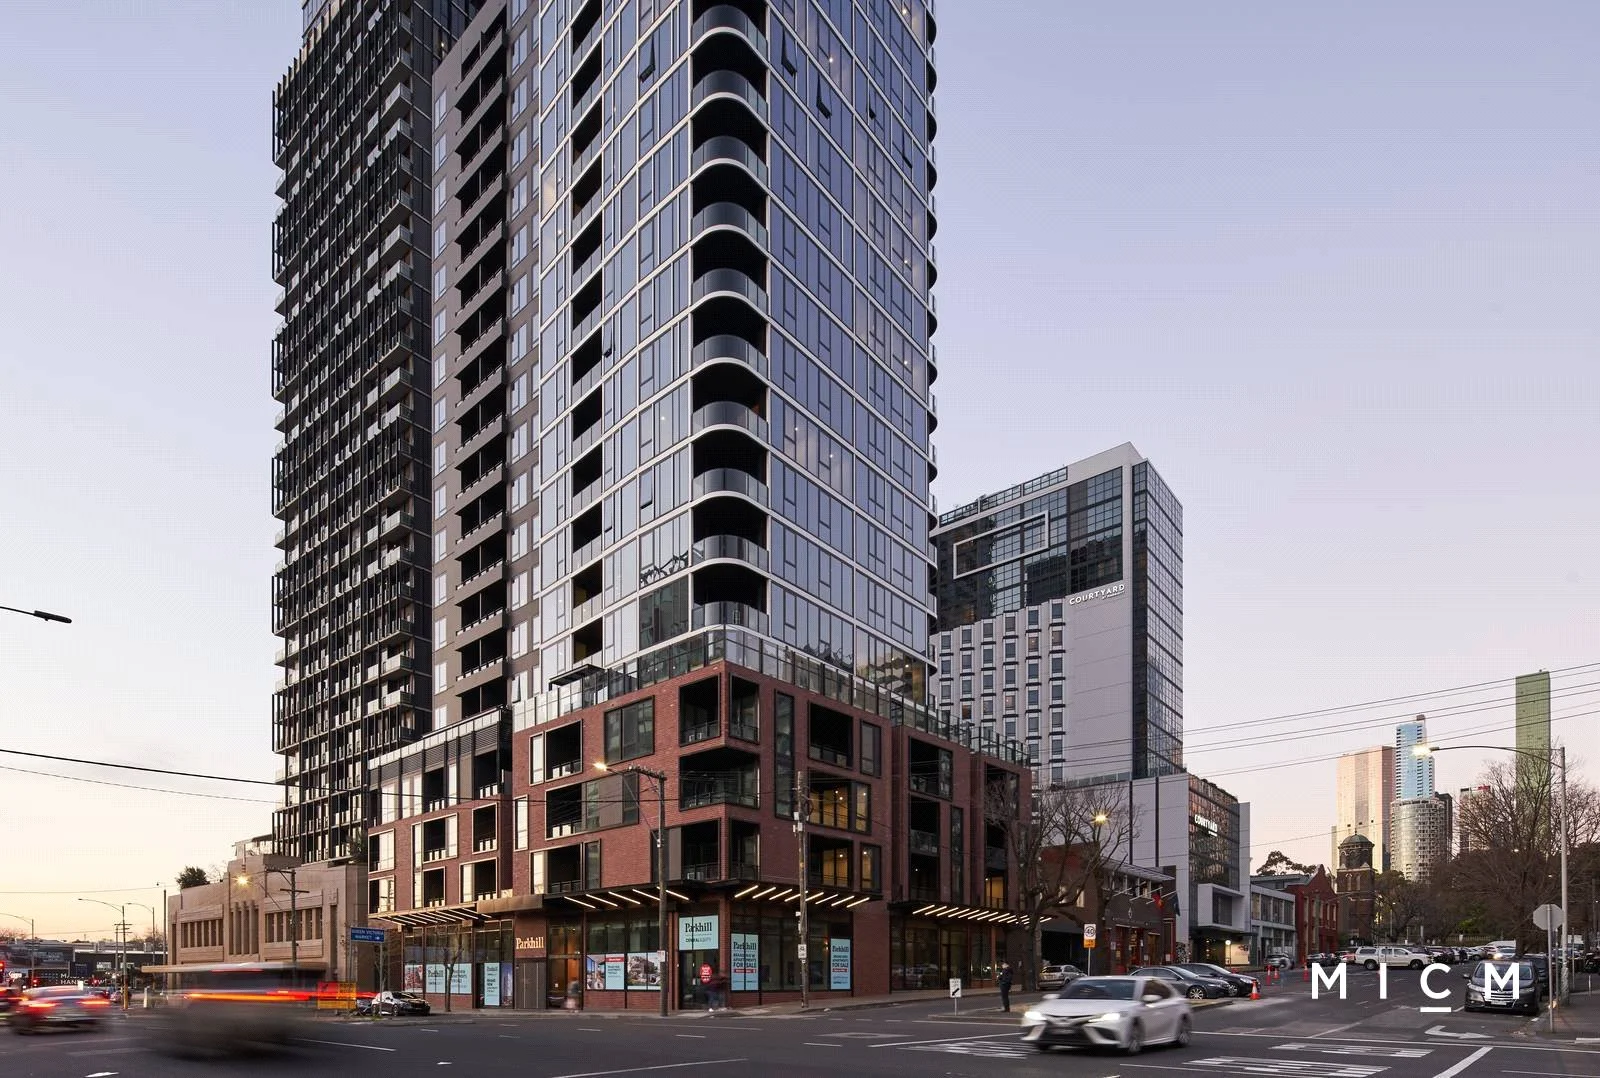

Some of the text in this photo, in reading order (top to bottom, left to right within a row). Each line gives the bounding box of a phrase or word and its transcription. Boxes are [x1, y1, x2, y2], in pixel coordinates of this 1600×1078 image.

[1070, 584, 1125, 605] COURTYARD
[685, 922, 712, 932] Parkhill
[515, 937, 544, 949] Parkhill
